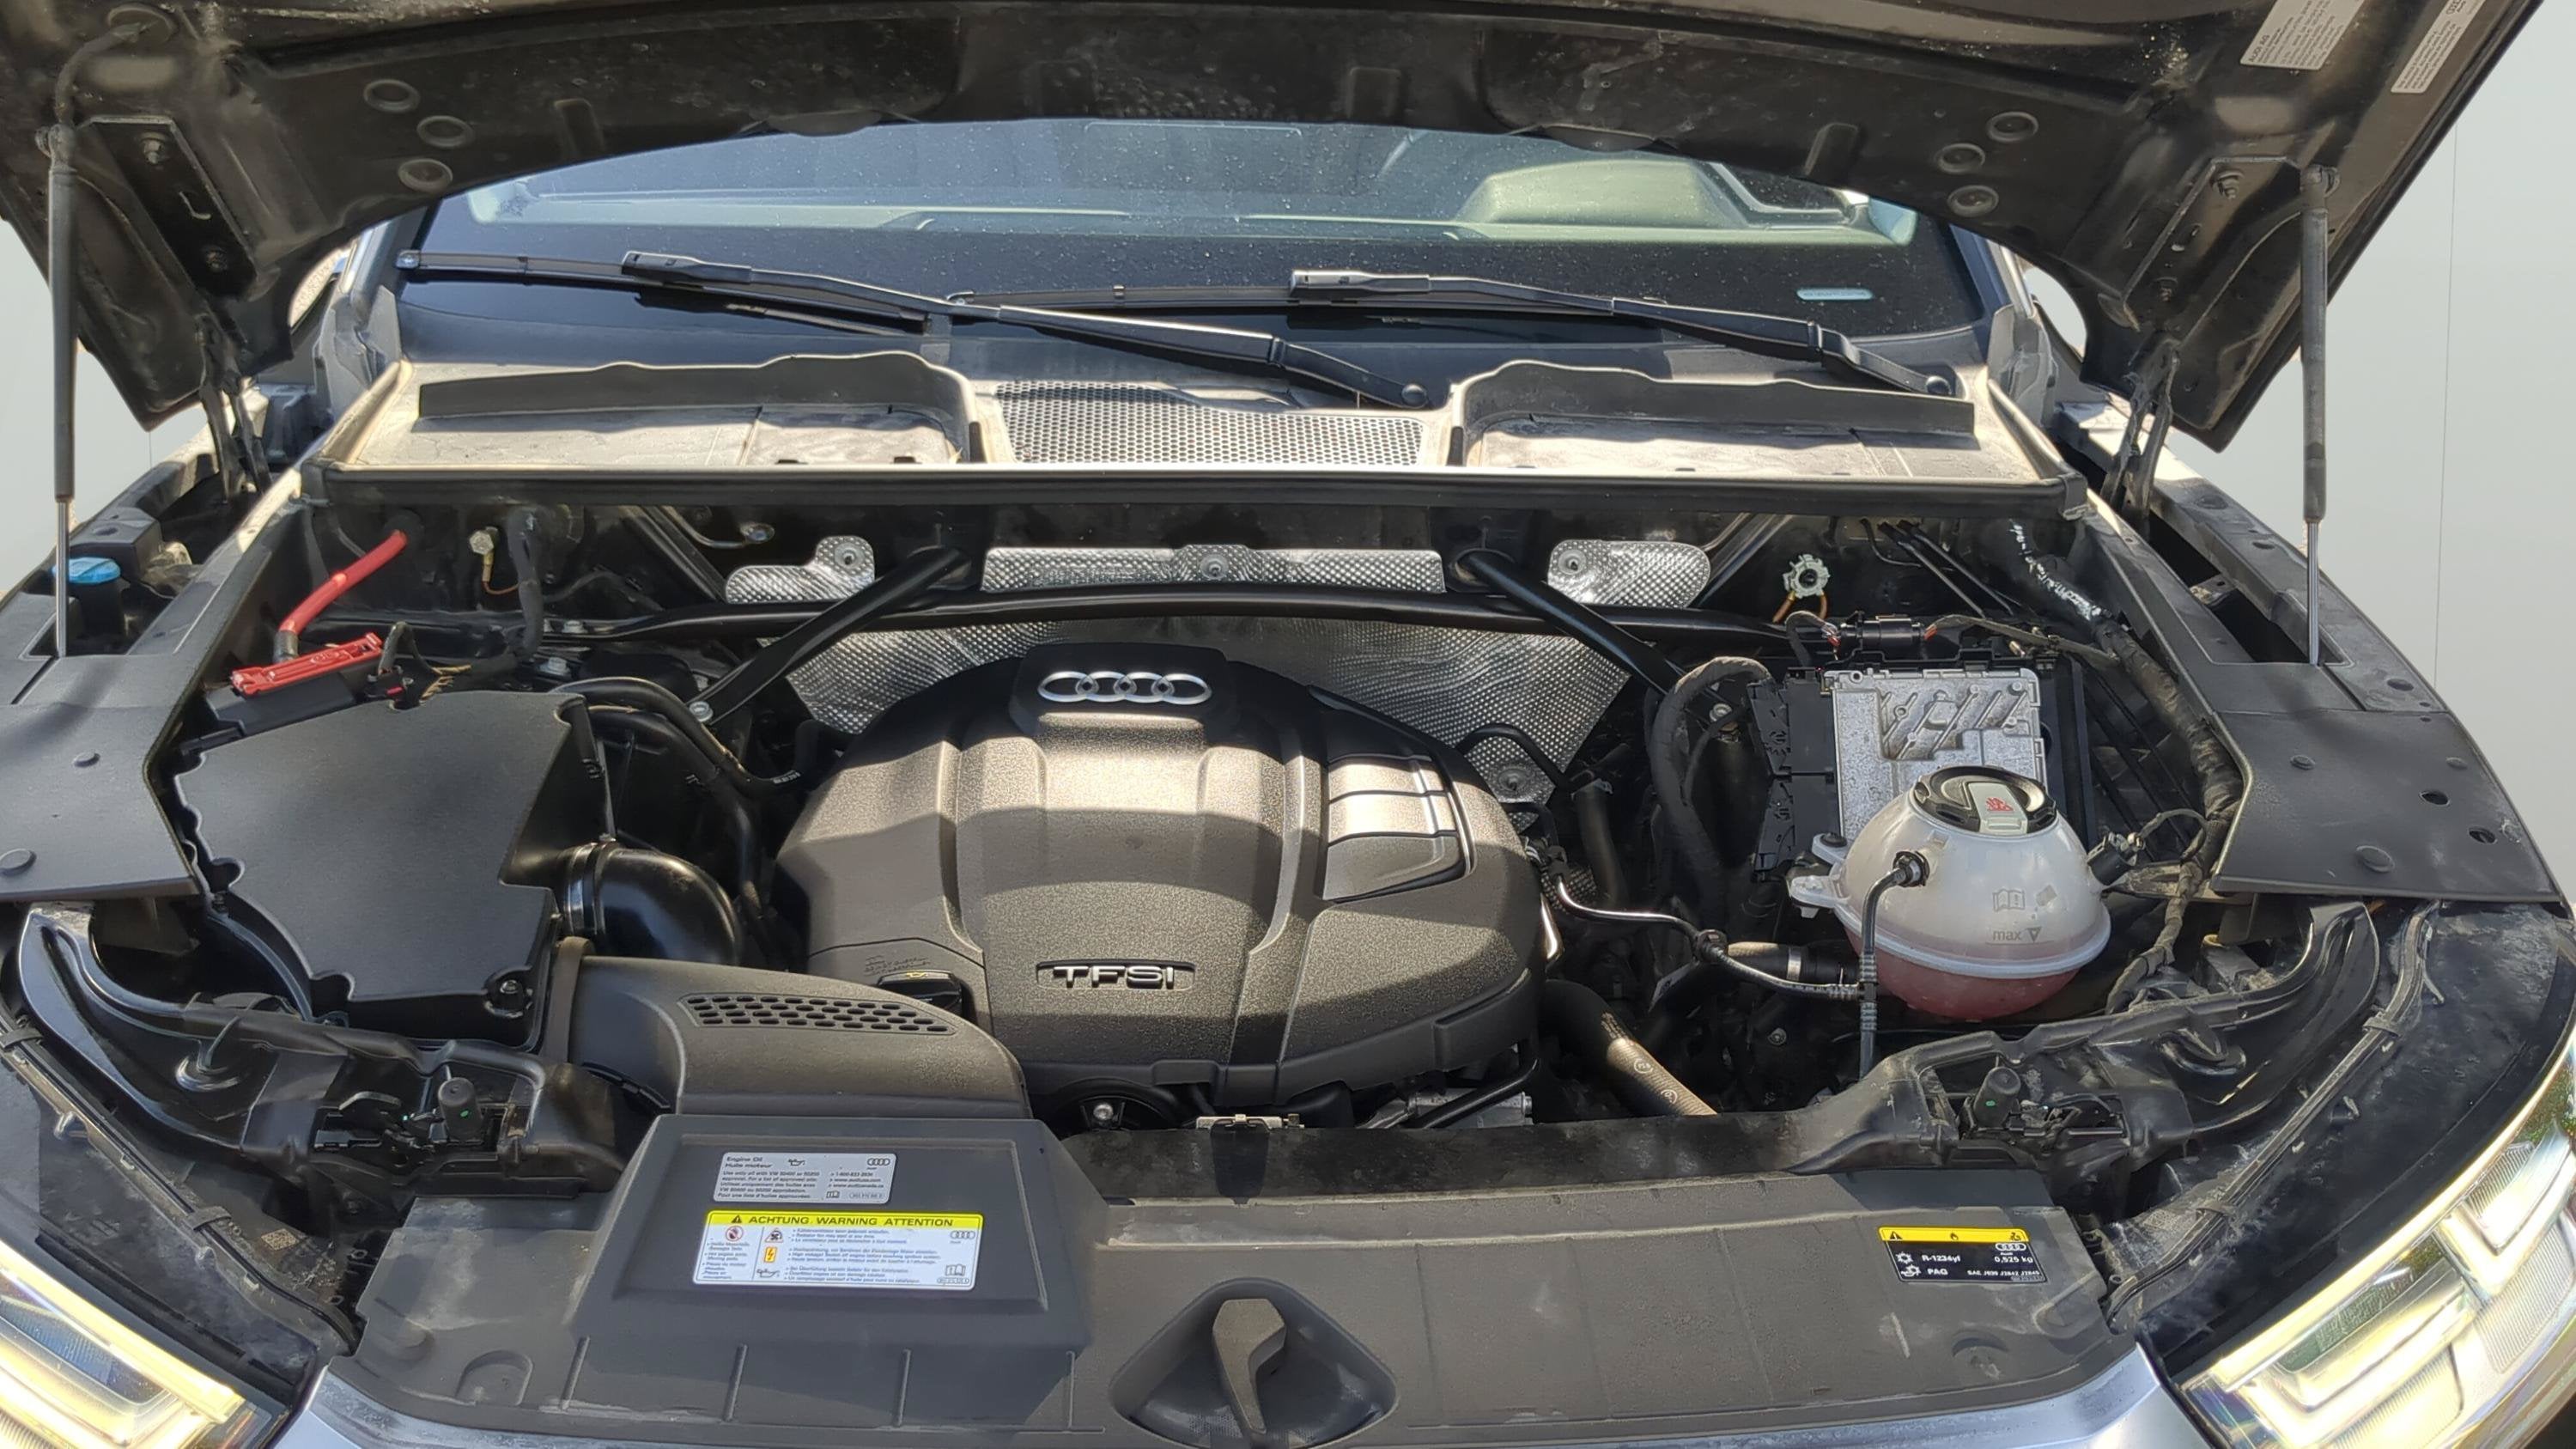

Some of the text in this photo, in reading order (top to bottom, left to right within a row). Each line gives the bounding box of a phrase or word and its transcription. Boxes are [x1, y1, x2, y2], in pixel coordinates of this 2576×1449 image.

[1993, 930, 2021, 941] max
[1053, 965, 1175, 989] TFSI
[749, 1215, 953, 1227] ACHTUNG WARNING ATTENTION
